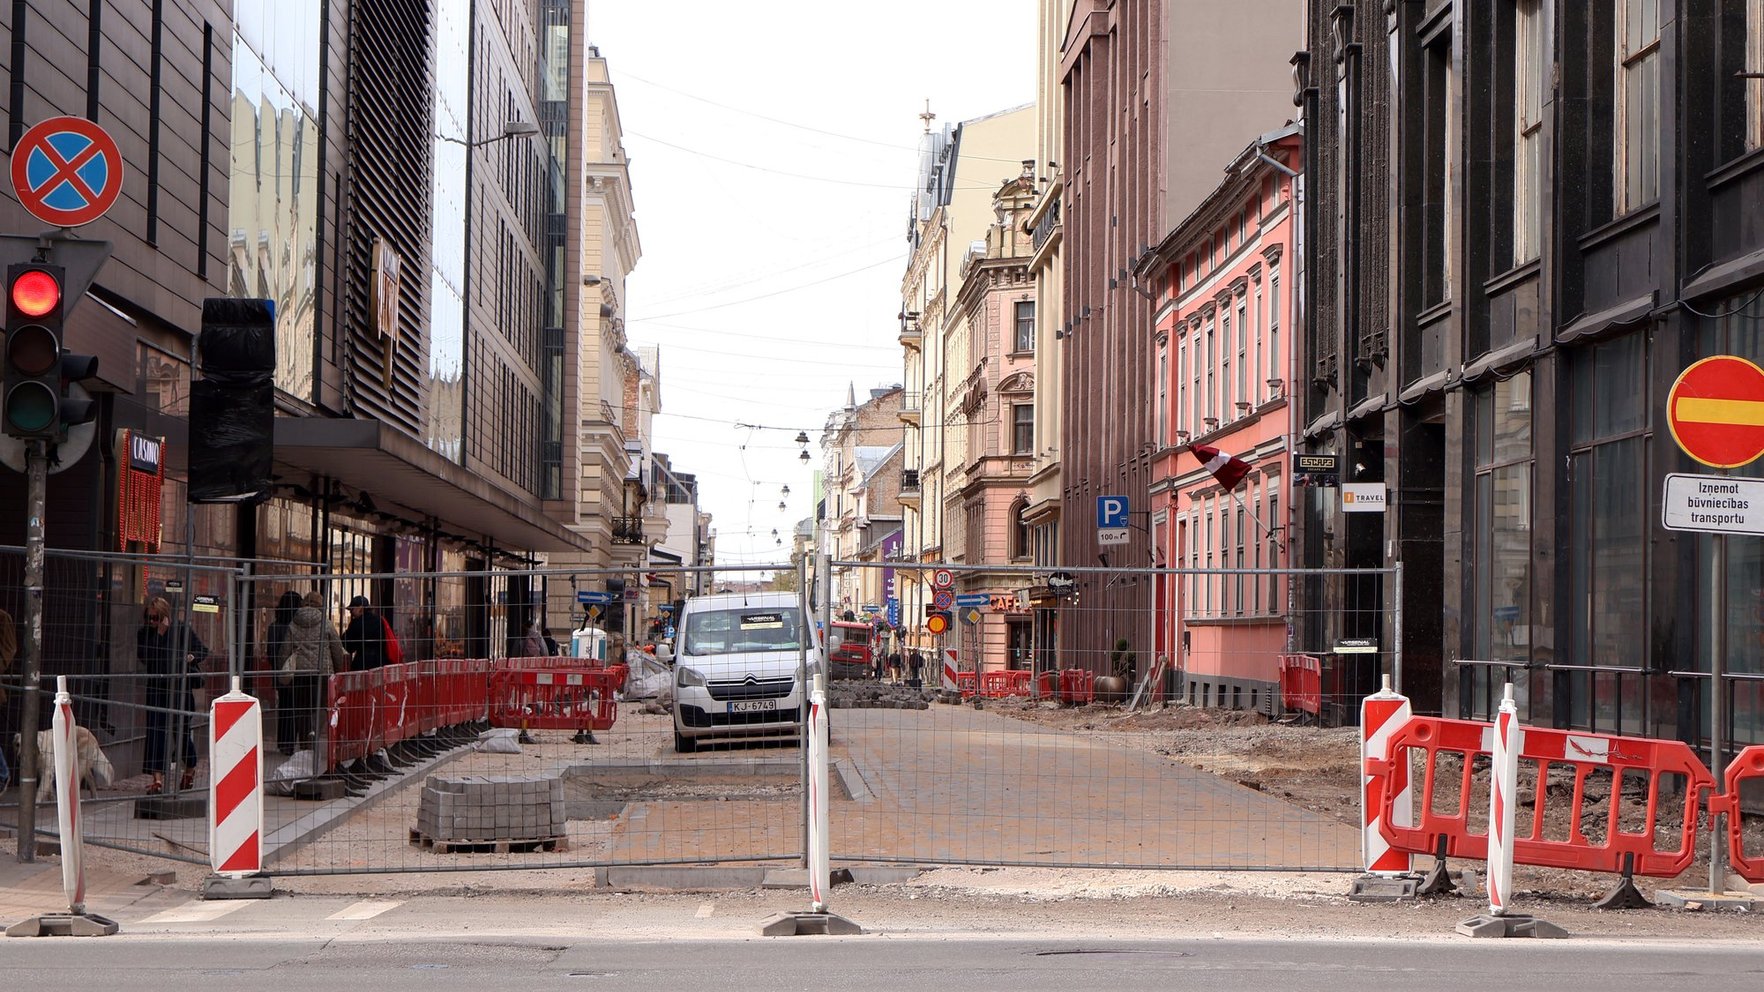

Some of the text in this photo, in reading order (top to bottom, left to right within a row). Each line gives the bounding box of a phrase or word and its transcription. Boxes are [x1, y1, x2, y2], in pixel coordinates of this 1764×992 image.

[134, 435, 160, 465] CASINO
[1699, 482, 1739, 496] Izņemot
[1688, 496, 1749, 509] būvniecības
[1104, 500, 1122, 524] P
[1691, 512, 1745, 526] transportu
[1101, 533, 1113, 541] 100
[938, 574, 948, 583] 30
[734, 701, 774, 711] KJ-6749
